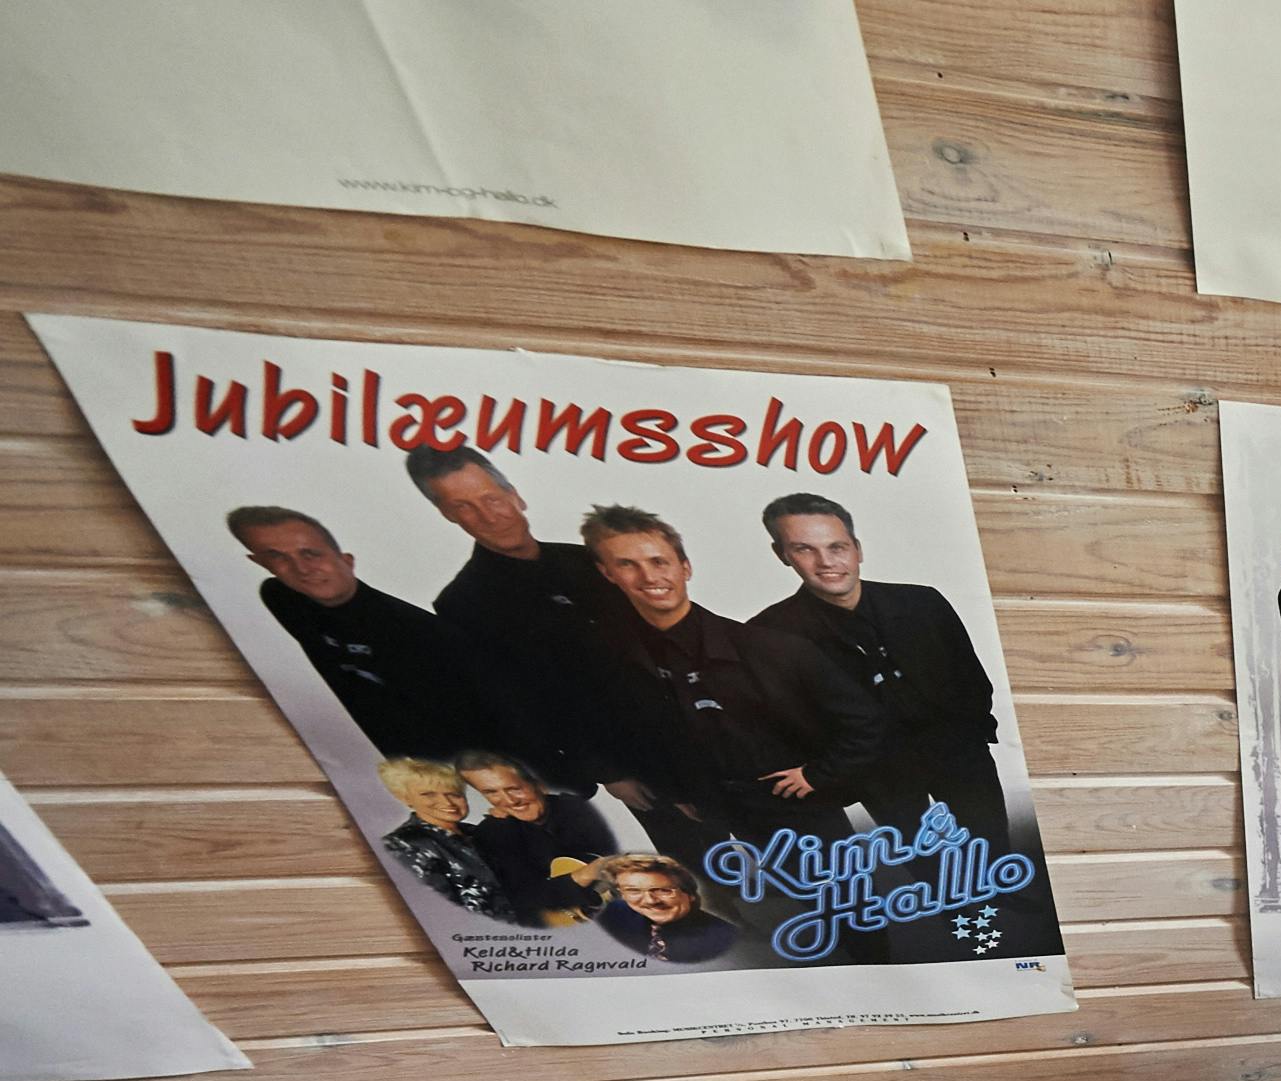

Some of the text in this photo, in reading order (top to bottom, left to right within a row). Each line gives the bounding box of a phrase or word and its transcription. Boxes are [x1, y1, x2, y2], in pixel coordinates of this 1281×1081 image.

[133, 351, 926, 477] Jubilæumsshow
[703, 824, 905, 903] Kim
[772, 837, 1036, 960] Hallo
[463, 946, 579, 959] Keld&Hilda
[472, 958, 647, 973] Richard Ragnvald
